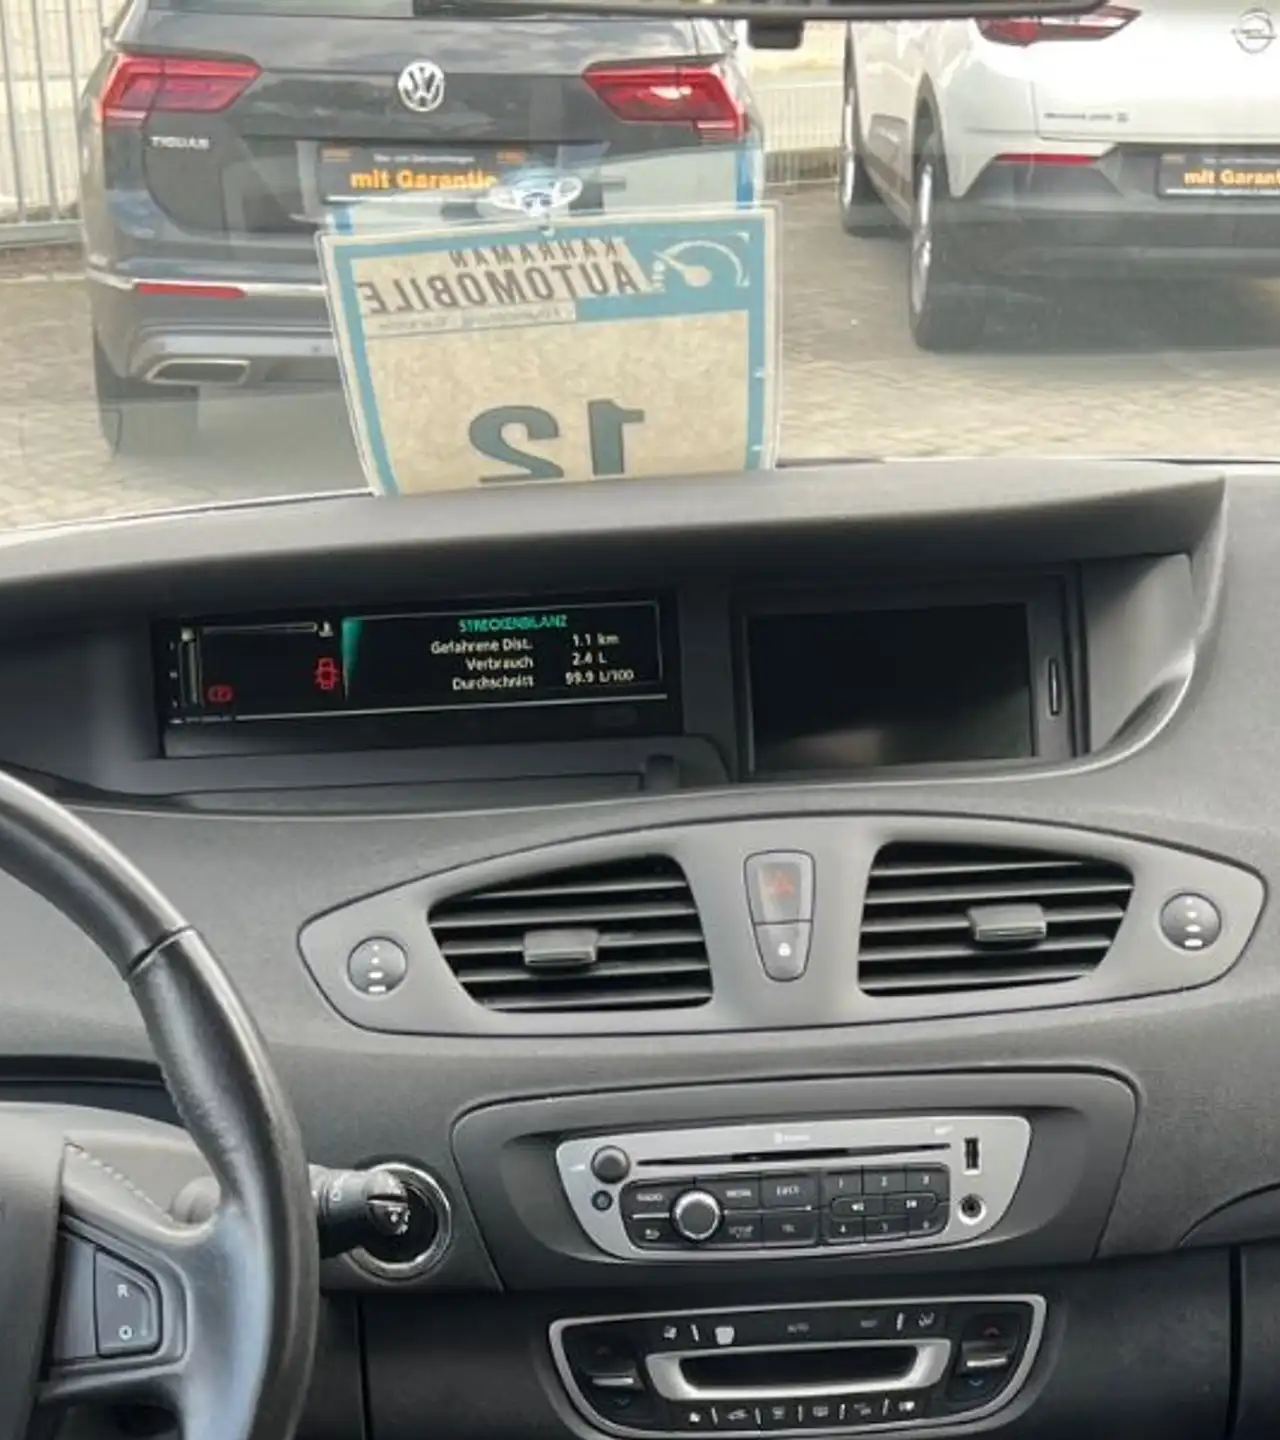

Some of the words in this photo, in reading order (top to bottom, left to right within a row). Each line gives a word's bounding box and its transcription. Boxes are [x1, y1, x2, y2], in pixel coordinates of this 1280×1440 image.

[149, 136, 209, 150] TIGUAN
[351, 169, 389, 189] mit
[1184, 168, 1216, 185] mit
[431, 638, 500, 656] Gefahrene
[572, 634, 592, 647] 1.1
[597, 632, 621, 645] km
[464, 656, 535, 671] Verbrauch
[598, 652, 608, 664] L
[452, 674, 535, 692] Durchschnitt
[117, 1284, 129, 1298] R
